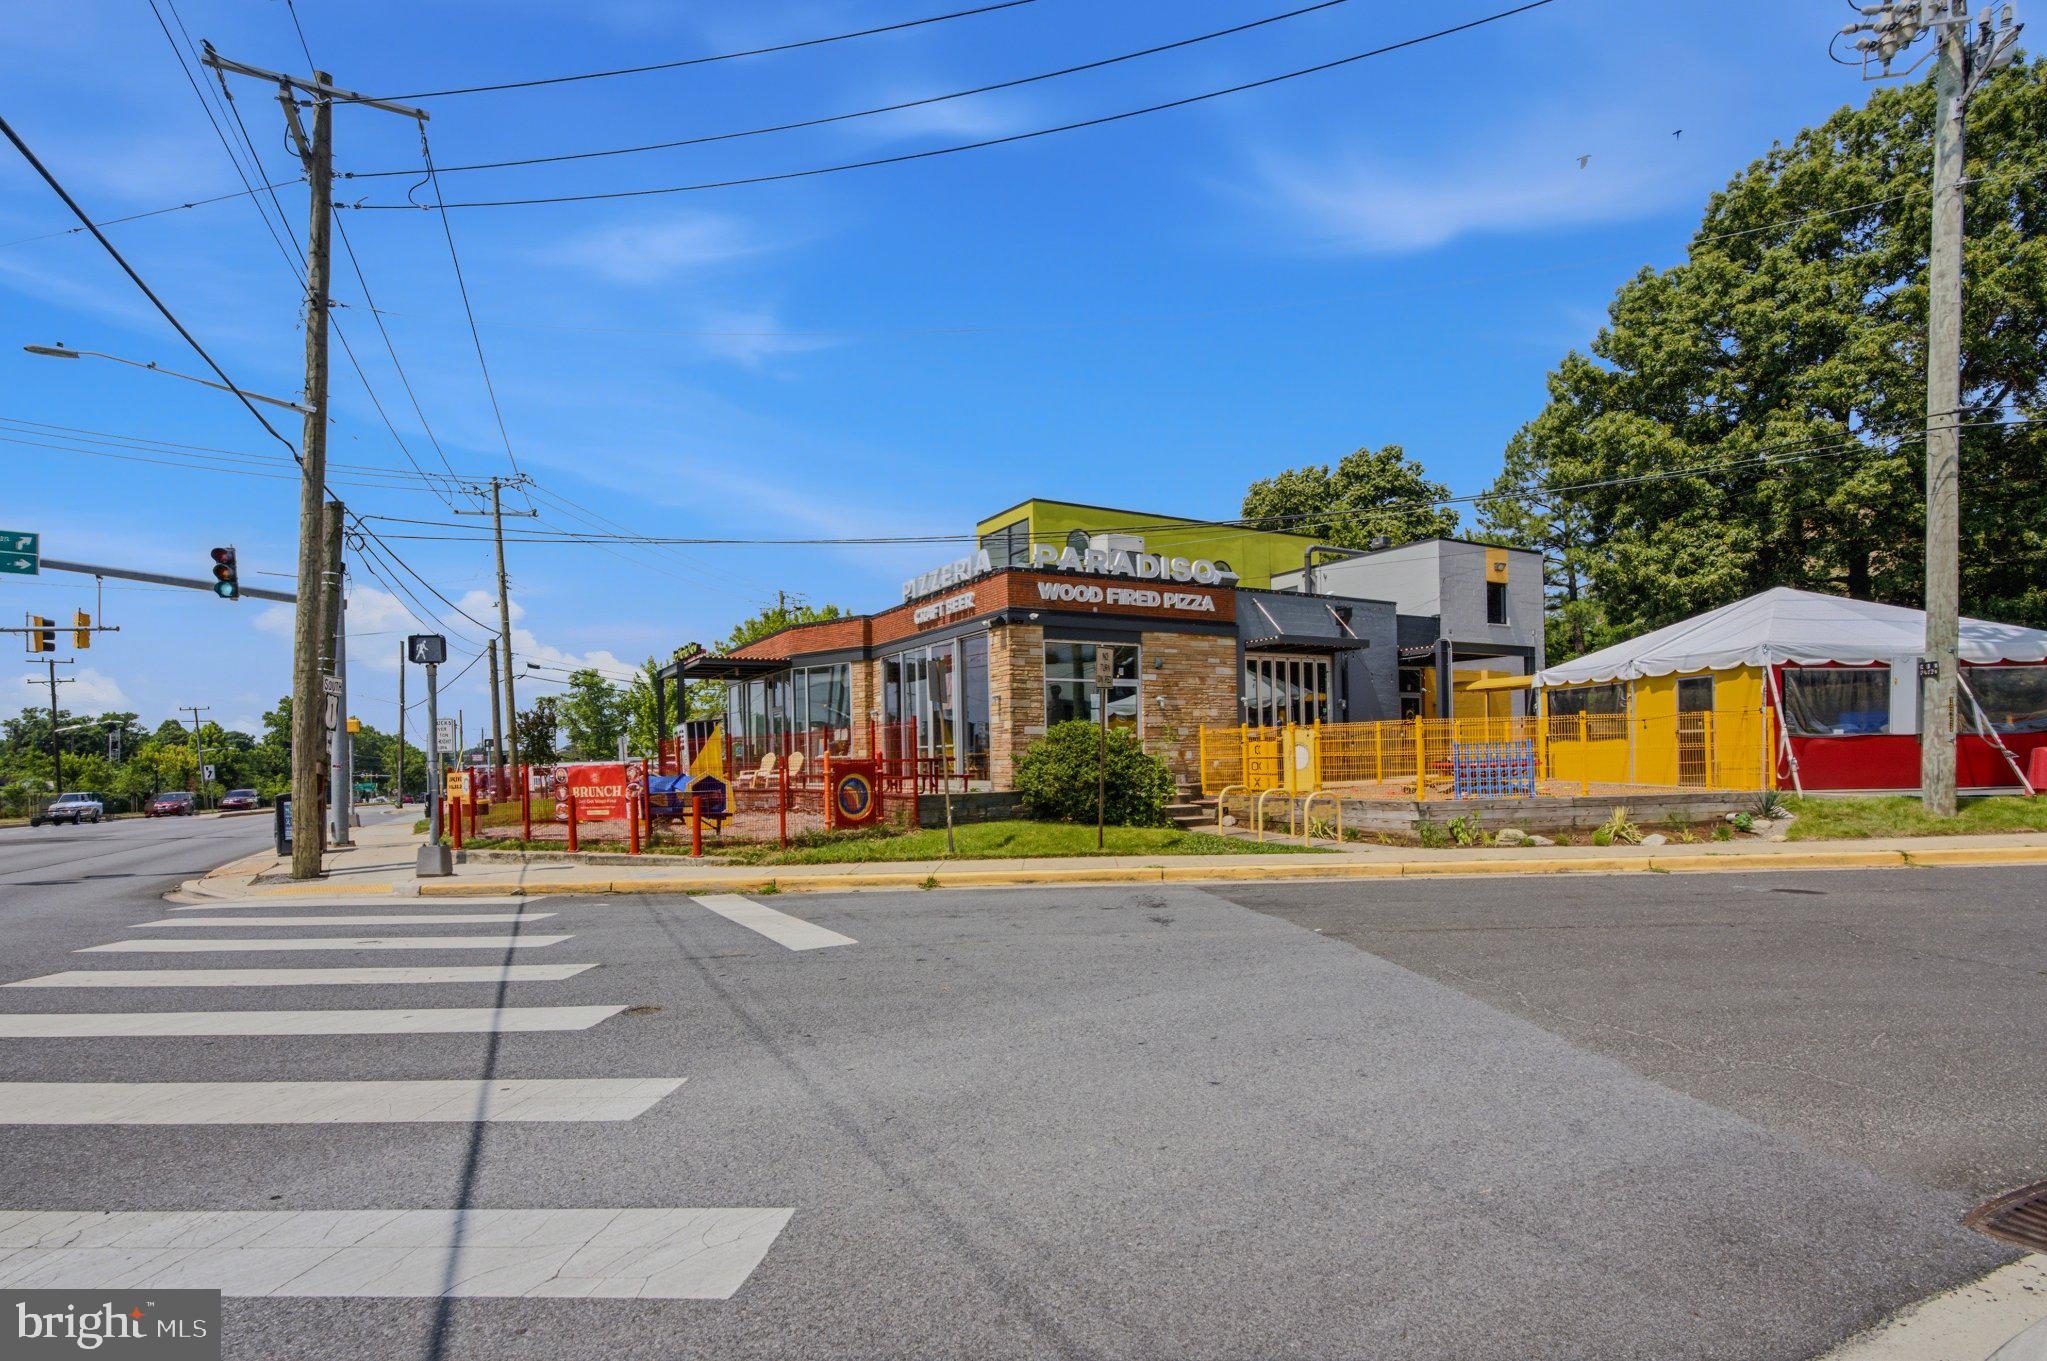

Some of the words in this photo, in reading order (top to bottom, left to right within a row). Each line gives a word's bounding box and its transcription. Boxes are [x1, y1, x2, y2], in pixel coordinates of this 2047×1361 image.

[902, 549, 992, 603] PIZZERIA
[1034, 543, 1216, 584] PARADISO
[946, 591, 976, 615] BEER
[1037, 581, 1104, 603] WOOD
[1106, 587, 1161, 607] FIRED
[1163, 592, 1216, 612] PIZZA
[572, 785, 622, 798] BRUNCH
